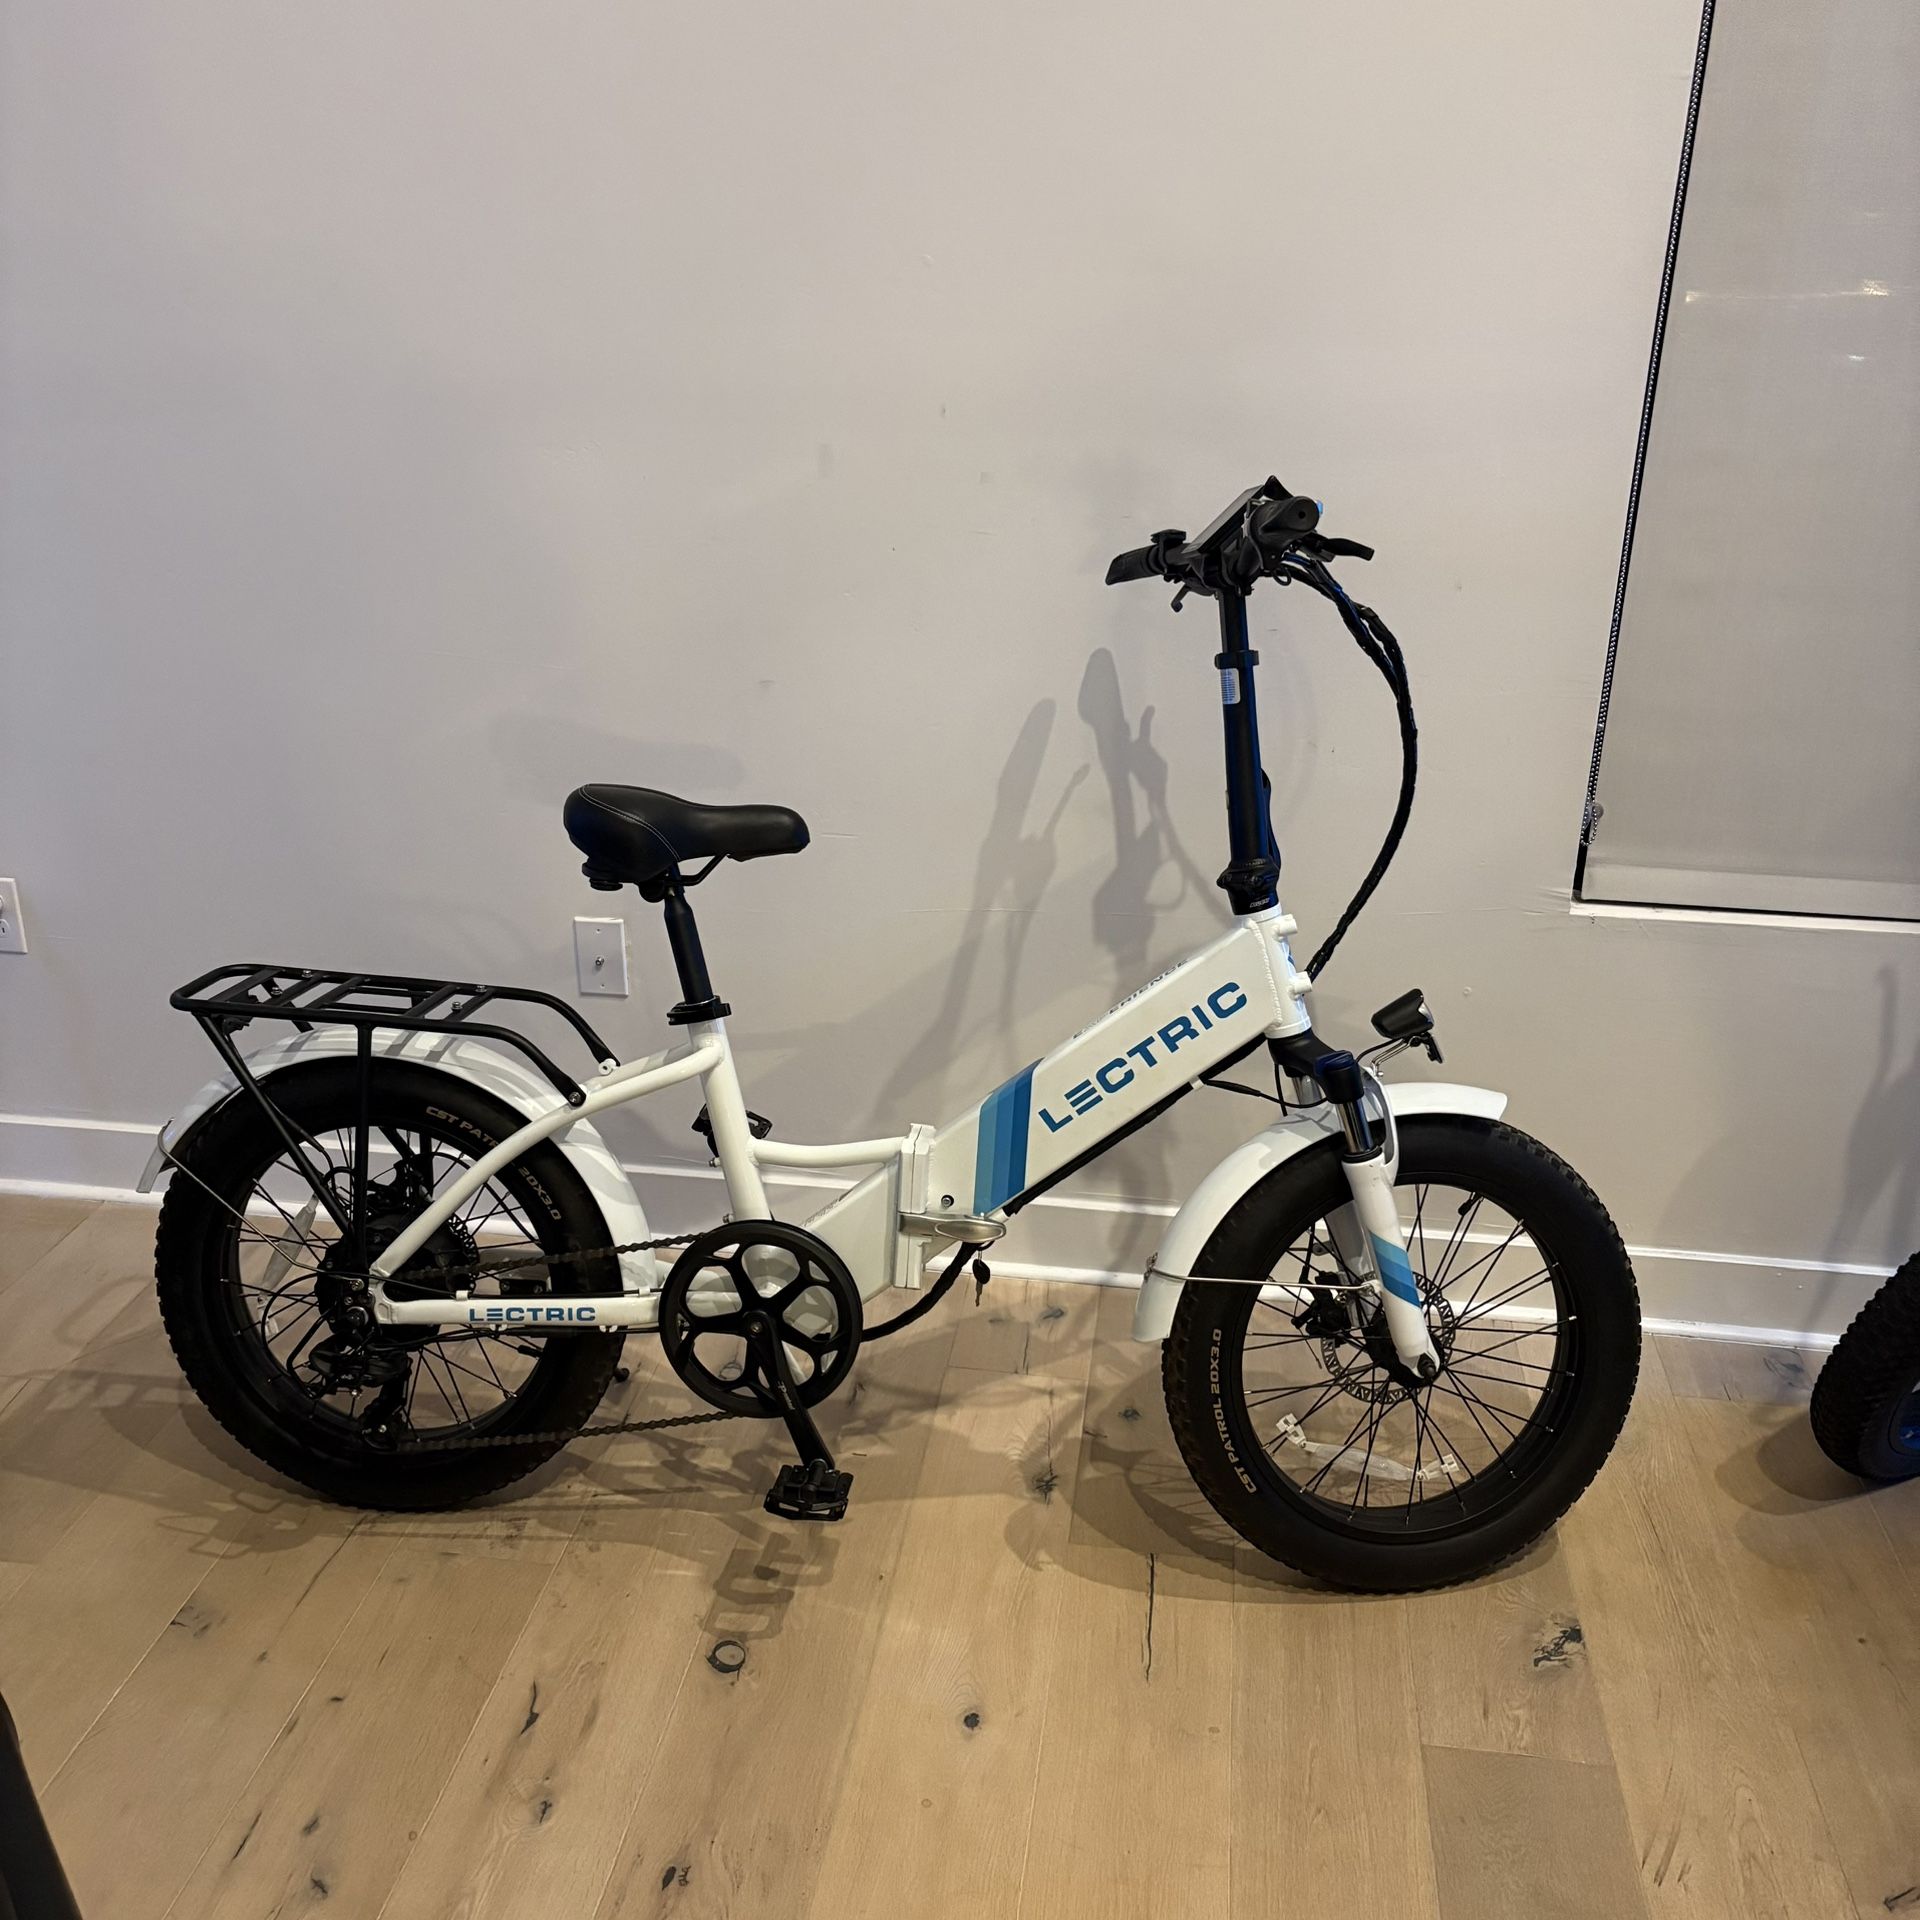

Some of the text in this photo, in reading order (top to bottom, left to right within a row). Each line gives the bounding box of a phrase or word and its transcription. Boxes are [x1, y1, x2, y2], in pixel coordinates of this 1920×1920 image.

[1038, 981, 1248, 1133] LECTRIC
[425, 1105, 460, 1124] CST
[518, 1167, 562, 1220] 20X3.0
[469, 1307, 596, 1322] LECTRIC
[1210, 1328, 1257, 1494] CST PATROL 20X3.0
